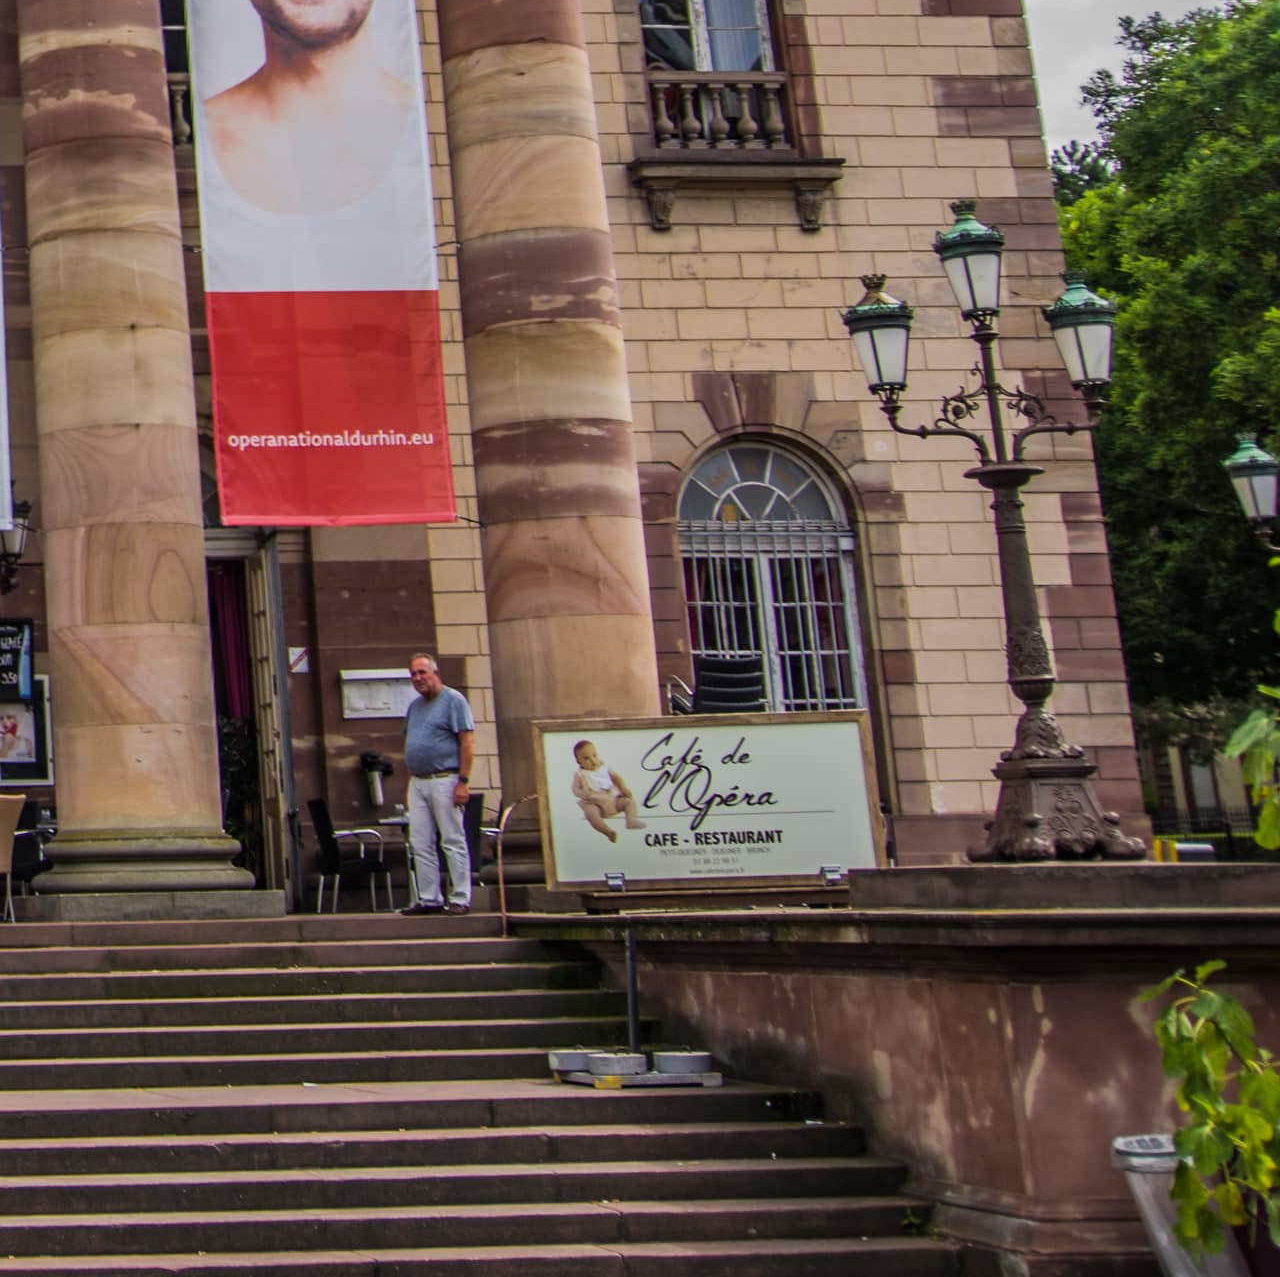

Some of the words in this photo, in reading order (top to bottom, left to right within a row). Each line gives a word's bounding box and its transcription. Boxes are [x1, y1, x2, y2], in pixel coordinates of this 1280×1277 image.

[228, 429, 434, 450] operanationaldurhin.eu
[640, 732, 704, 783] Café
[721, 737, 752, 765] de
[644, 833, 679, 847] CAFE
[694, 830, 783, 845] RESTAURANT
